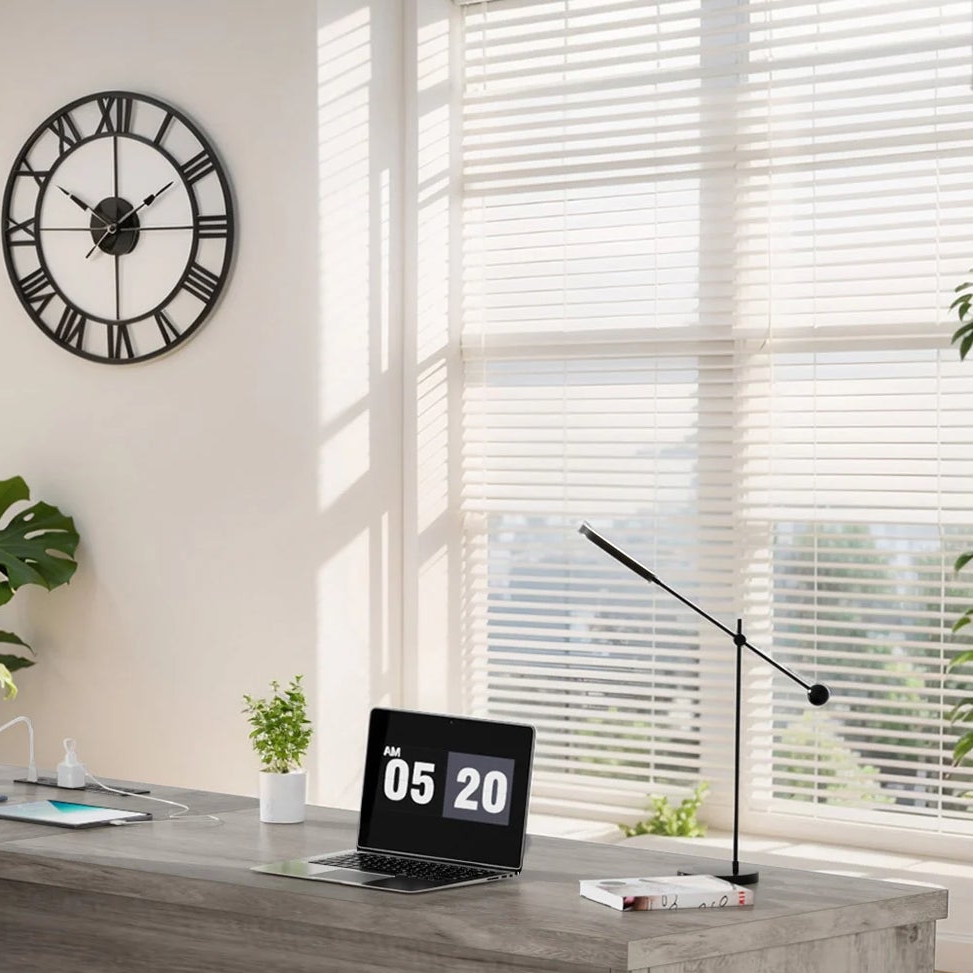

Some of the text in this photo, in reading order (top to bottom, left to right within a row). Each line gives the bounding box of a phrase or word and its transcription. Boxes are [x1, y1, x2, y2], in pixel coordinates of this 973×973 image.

[95, 97, 133, 134] XII
[383, 745, 401, 757] AM
[383, 758, 508, 814] 05 20
